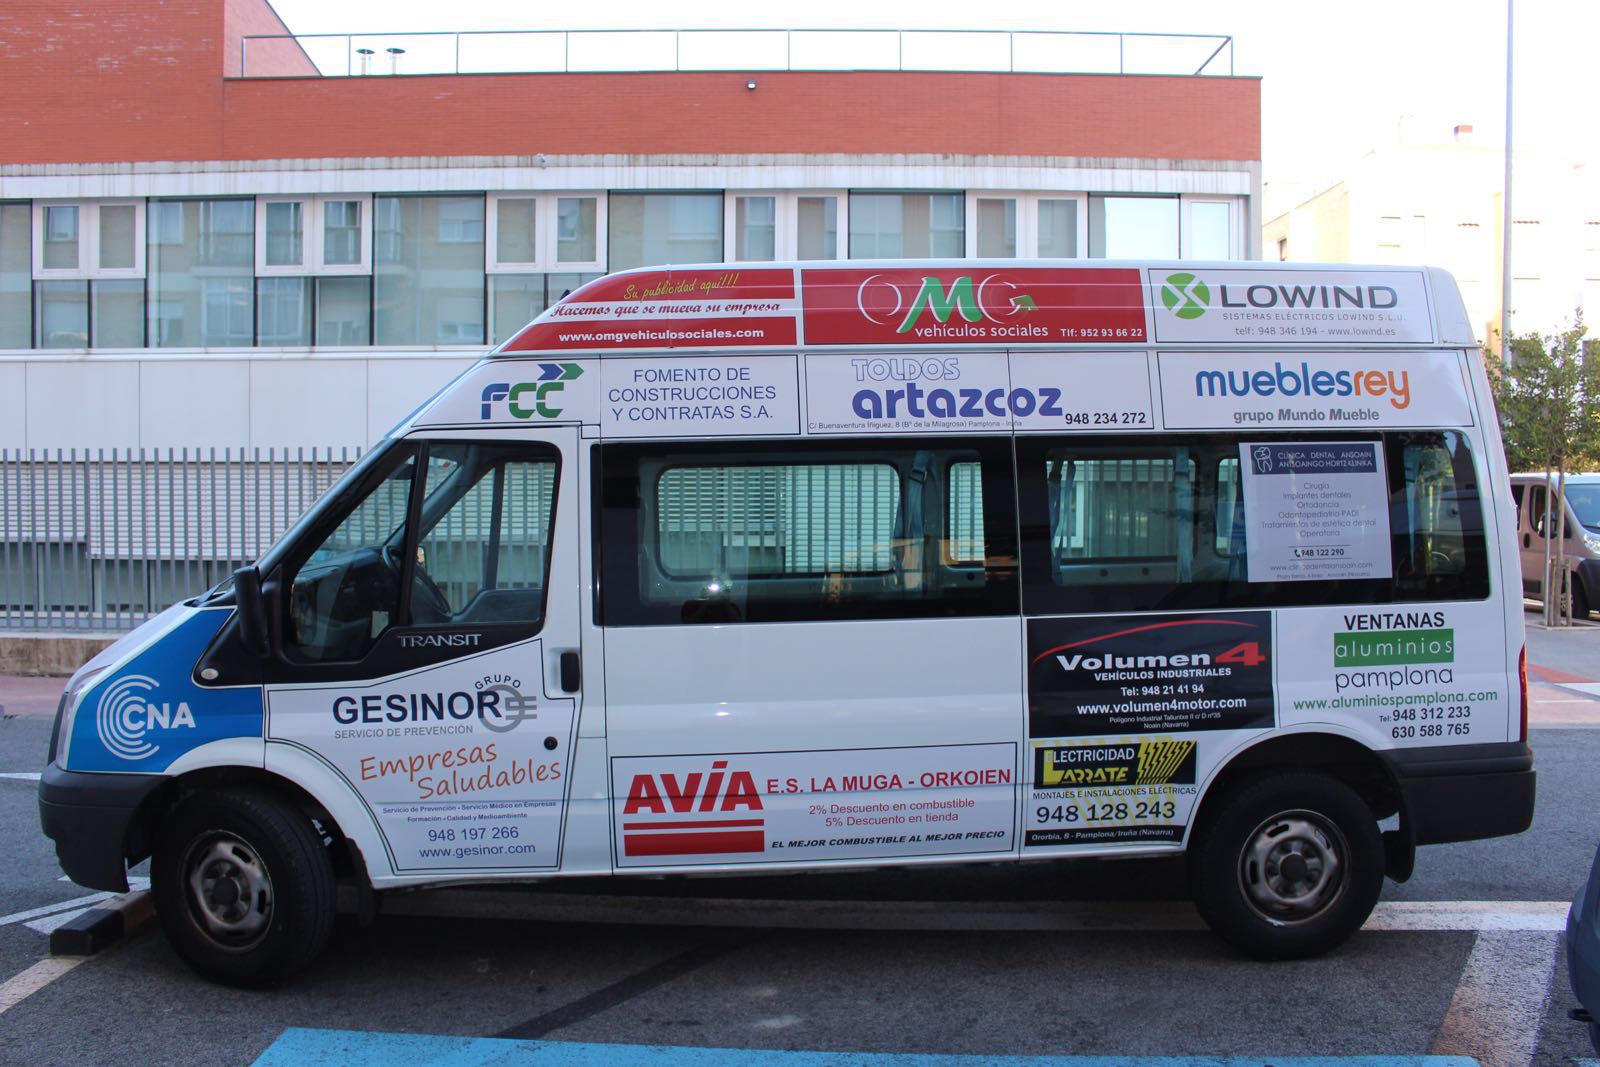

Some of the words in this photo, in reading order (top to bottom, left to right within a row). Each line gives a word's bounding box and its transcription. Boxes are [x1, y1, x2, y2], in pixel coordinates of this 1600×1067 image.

[624, 284, 639, 300] Su
[641, 278, 695, 303] publicidad
[1220, 285, 1398, 309] LOWIND
[550, 304, 611, 317] Hacemos
[615, 305, 639, 317] que
[643, 304, 655, 314] se
[658, 302, 702, 314] mueva
[705, 303, 721, 313] su
[724, 302, 781, 315] empresa
[857, 273, 1037, 333] OMG
[1222, 312, 1272, 321] SISTEMAS
[1275, 311, 1335, 321] ELÉCTRICOS
[1337, 313, 1375, 321] LOWIND
[559, 328, 765, 344] www.omgvehiculosociales.com
[915, 322, 986, 338] vehículos
[990, 322, 1049, 338] sociales
[1080, 328, 1099, 338] 952
[1101, 328, 1114, 338] 93
[1116, 328, 1128, 338] 66
[1131, 328, 1143, 338] 22
[1235, 326, 1254, 335] telf:
[1258, 327, 1276, 335] 948
[1279, 327, 1297, 335] 346
[1301, 327, 1318, 335] 194
[1328, 326, 1397, 336] www.lowind.es
[633, 368, 721, 383] FOMENTO
[726, 367, 751, 382] DE
[851, 358, 961, 381] TOLDOS
[608, 385, 777, 403] CONSTRUCCIONES
[1195, 362, 1411, 410] mueblesrey
[481, 382, 565, 420] FCC
[852, 382, 1063, 420] artazcoz
[611, 407, 625, 421] Y
[628, 405, 736, 421] CONTRATAS
[740, 405, 774, 420] S.A.
[1065, 412, 1090, 425] 948
[1093, 412, 1119, 425] 234
[1122, 412, 1147, 425] 272
[1234, 410, 1275, 424] grupo
[1277, 409, 1326, 422] Mundo
[1329, 408, 1380, 421] Mueble
[818, 421, 866, 429] Buenaventura
[931, 420, 967, 429] Milagrosa)
[1310, 451, 1336, 459] DENTAL
[1301, 549, 1314, 557] 948
[1331, 548, 1345, 556] 290
[1344, 612, 1445, 631] VENTANAS
[399, 633, 482, 648] TRANSIT
[1335, 637, 1453, 658] aluminios
[1056, 653, 1211, 671] Volumen
[1215, 641, 1266, 667] 4
[475, 674, 521, 690] GRUPO
[1094, 670, 1154, 682] VEHÍCULOS
[1156, 667, 1232, 679] INDUSTRIALES
[1336, 666, 1453, 693] pamplona
[1120, 687, 1139, 697] Tel:
[1141, 685, 1161, 696] 948
[1163, 685, 1174, 695] 21
[1177, 684, 1189, 695] 41
[1192, 684, 1205, 694] 94
[332, 690, 503, 724] GESINOR
[1077, 698, 1247, 715] www.volumen4motor.com
[1293, 690, 1498, 711] www.aluminiospamplona.com
[1379, 715, 1392, 723] Tel:
[1393, 708, 1416, 722] 948
[1420, 707, 1444, 720] 312
[1447, 706, 1471, 719] 233
[334, 728, 384, 739] SERVICIO
[386, 727, 402, 737] DE
[404, 725, 474, 737] PREVENCIÓN
[1392, 725, 1415, 739] 630
[1419, 724, 1443, 738] 588
[1447, 723, 1470, 736] 765
[360, 742, 498, 783] Empresas
[417, 759, 562, 800] Saludables
[766, 778, 804, 794] E.S.
[811, 776, 837, 793] LA
[842, 774, 904, 792] MUGA
[920, 769, 1011, 788] ORKOIEN
[1033, 790, 1076, 800] MONTAJES
[1077, 790, 1083, 799] E
[1084, 787, 1147, 798] INSTALACIONES
[1148, 784, 1197, 795] ELÉCTRICAS
[382, 806, 410, 814] Servicio
[461, 803, 489, 811] Servicio
[808, 804, 827, 815] 2%
[830, 802, 890, 814] Descuento
[893, 803, 907, 811] en
[909, 798, 975, 810] combustible
[1036, 804, 1079, 824] 948
[1086, 802, 1129, 822] 128
[1135, 801, 1176, 820] 243
[825, 816, 843, 827] 5%
[846, 814, 906, 826] Descuento
[908, 814, 923, 823] en
[925, 812, 959, 822] tienda
[428, 829, 456, 842] 948
[461, 827, 486, 841] 197
[491, 826, 519, 839] 266
[771, 841, 785, 849] EL
[787, 839, 826, 848] MEJOR
[828, 836, 907, 847] COMBUSTIBLE
[908, 834, 923, 843] AL
[924, 832, 963, 842] MEJOR
[965, 830, 1006, 840] PRECIO
[418, 843, 536, 859] www.gesinor.com
